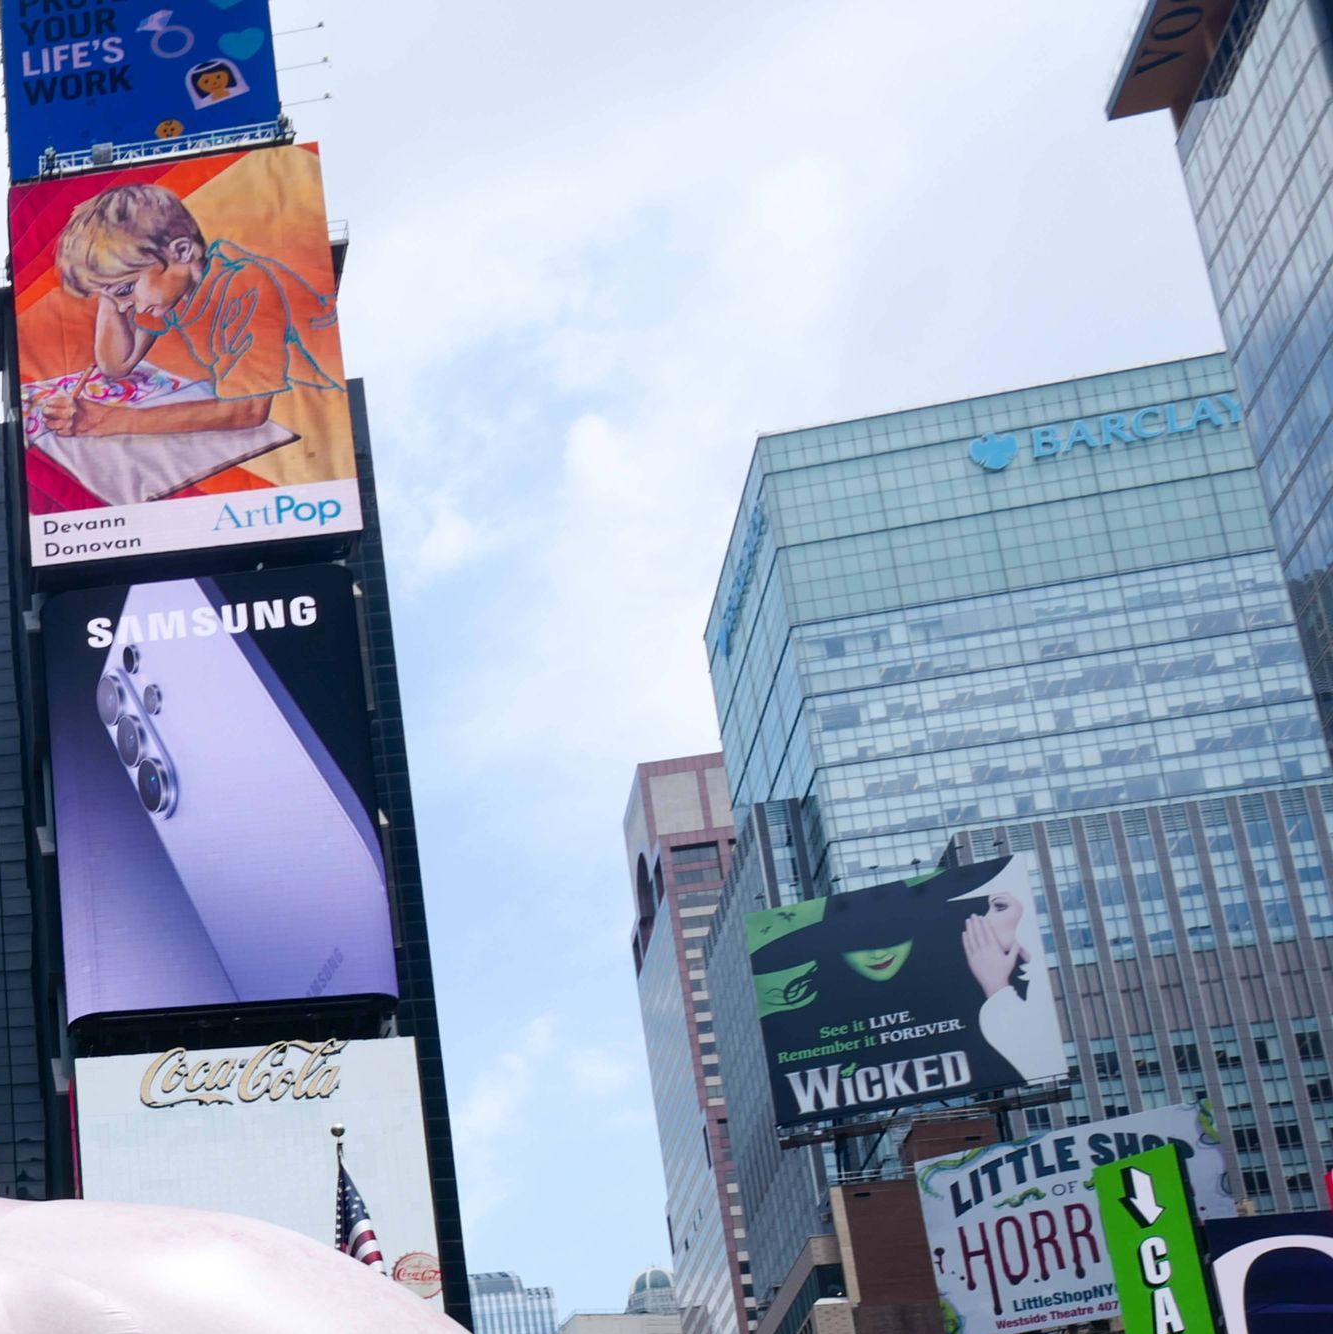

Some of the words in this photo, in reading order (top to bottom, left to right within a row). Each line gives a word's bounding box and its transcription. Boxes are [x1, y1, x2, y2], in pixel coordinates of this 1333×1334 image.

[20, 8, 117, 46] YOUR
[22, 36, 126, 77] LIFE'S
[23, 64, 134, 106] WORK
[43, 516, 126, 536] Devann
[213, 495, 342, 532] ArtPop
[44, 536, 142, 559] Donovan
[87, 595, 318, 649] SAMSUNG
[777, 1038, 861, 1065] Remember
[863, 1035, 878, 1048] it
[879, 1018, 967, 1046] FOREVER.
[819, 1023, 849, 1040] See
[852, 1019, 866, 1033] it
[868, 1010, 915, 1031] LIVE.
[140, 1038, 349, 1108] Coca-Cola
[949, 1135, 1081, 1219] LITTLE
[1051, 1180, 1078, 1197] OF
[995, 1312, 1048, 1331] Westside
[1049, 1305, 1094, 1321] Theatre
